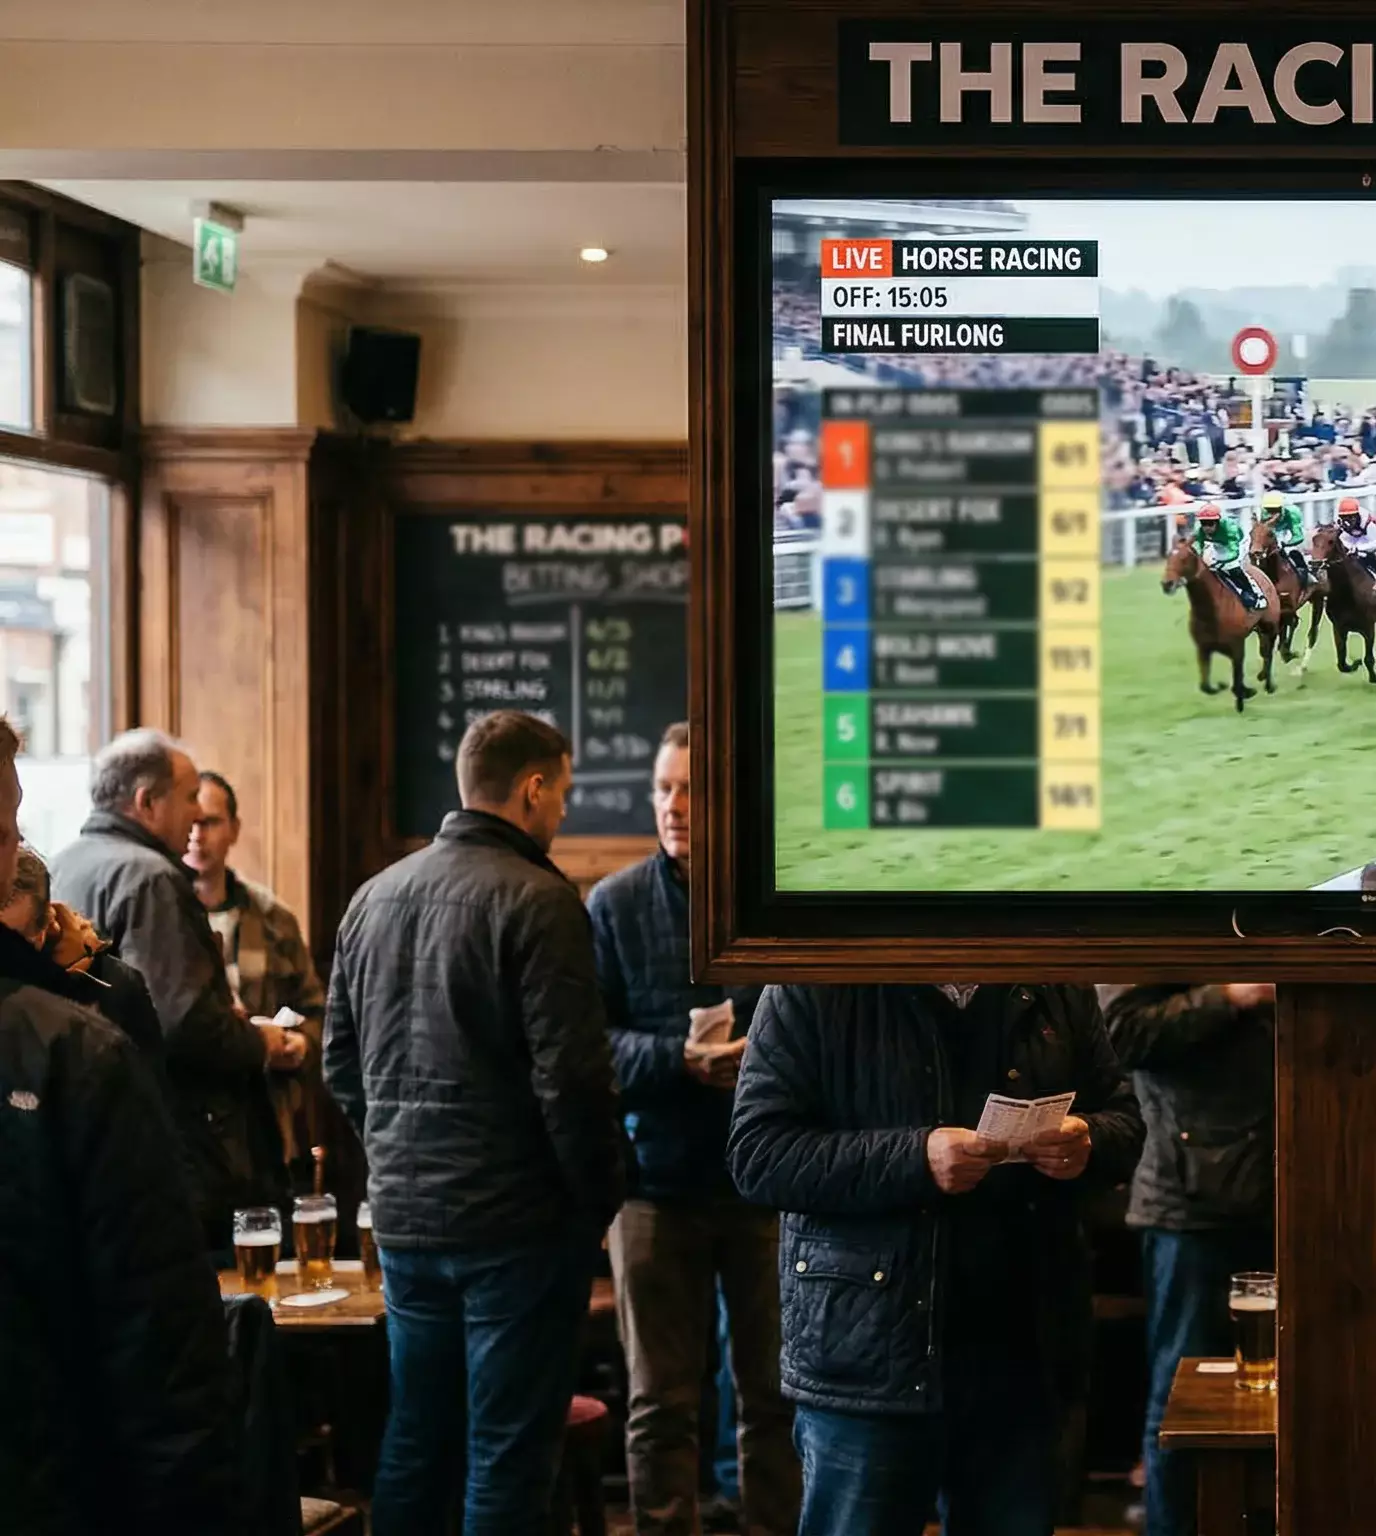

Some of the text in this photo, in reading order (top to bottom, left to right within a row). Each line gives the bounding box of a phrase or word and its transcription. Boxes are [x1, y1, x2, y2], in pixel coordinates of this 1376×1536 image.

[868, 41, 1082, 123] THE
[832, 247, 1082, 270] LIVE HORSE RACING
[833, 286, 948, 308] OFF: 15:05
[833, 323, 1004, 347] FINAL FURLONG
[839, 440, 855, 469] 1
[837, 507, 855, 538] 2
[450, 523, 516, 554] THE
[523, 522, 653, 553] RACING
[837, 575, 855, 606] 3
[835, 644, 856, 673] 4
[836, 713, 856, 742] 5
[835, 782, 856, 811] 6
